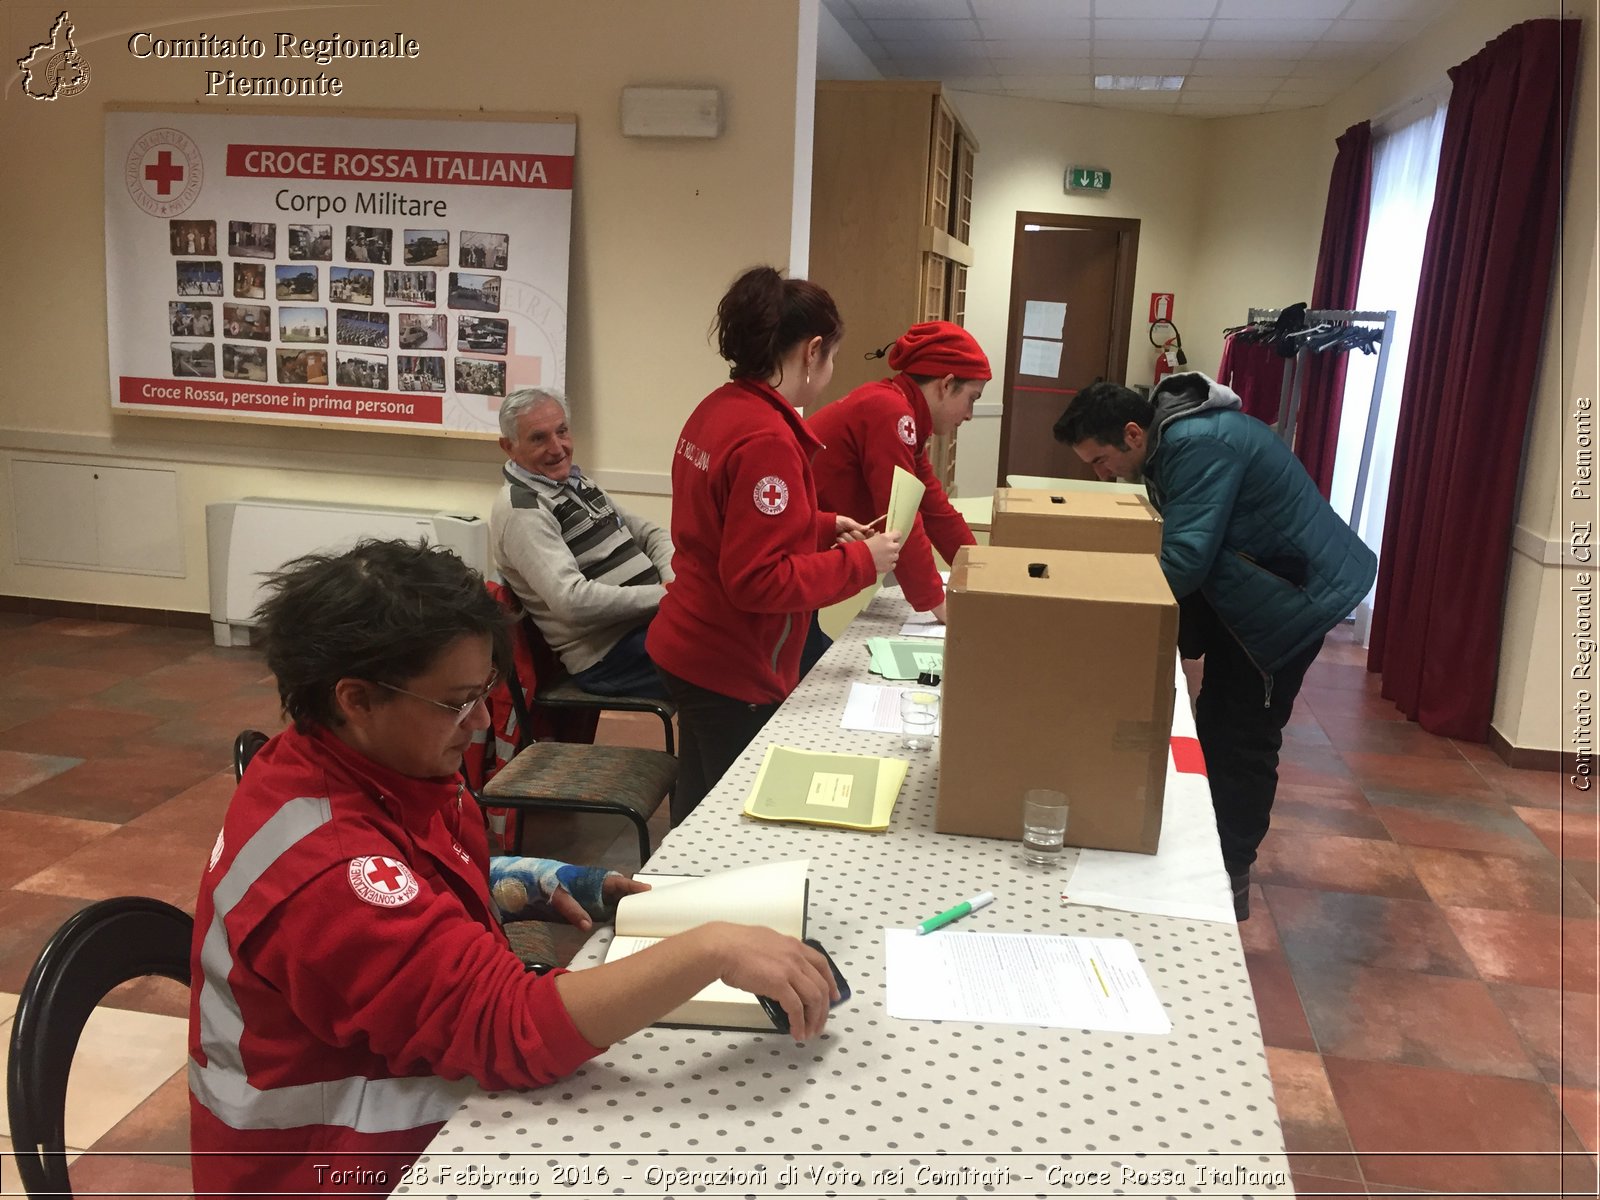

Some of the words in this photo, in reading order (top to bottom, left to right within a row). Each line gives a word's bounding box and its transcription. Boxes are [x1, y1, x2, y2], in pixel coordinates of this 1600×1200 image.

[244, 150, 326, 176] CROCE
[334, 152, 419, 179] ROSSA
[425, 155, 548, 184] ITALIANA
[275, 189, 346, 218] Corpo
[355, 192, 448, 218] Militare
[142, 383, 181, 400] Croce
[185, 386, 228, 405] Rossa,
[231, 391, 289, 408] persone
[292, 392, 306, 408] in
[309, 394, 352, 412] prima
[355, 397, 414, 415] persona
[350, 868, 396, 905] CONVENZIONE
